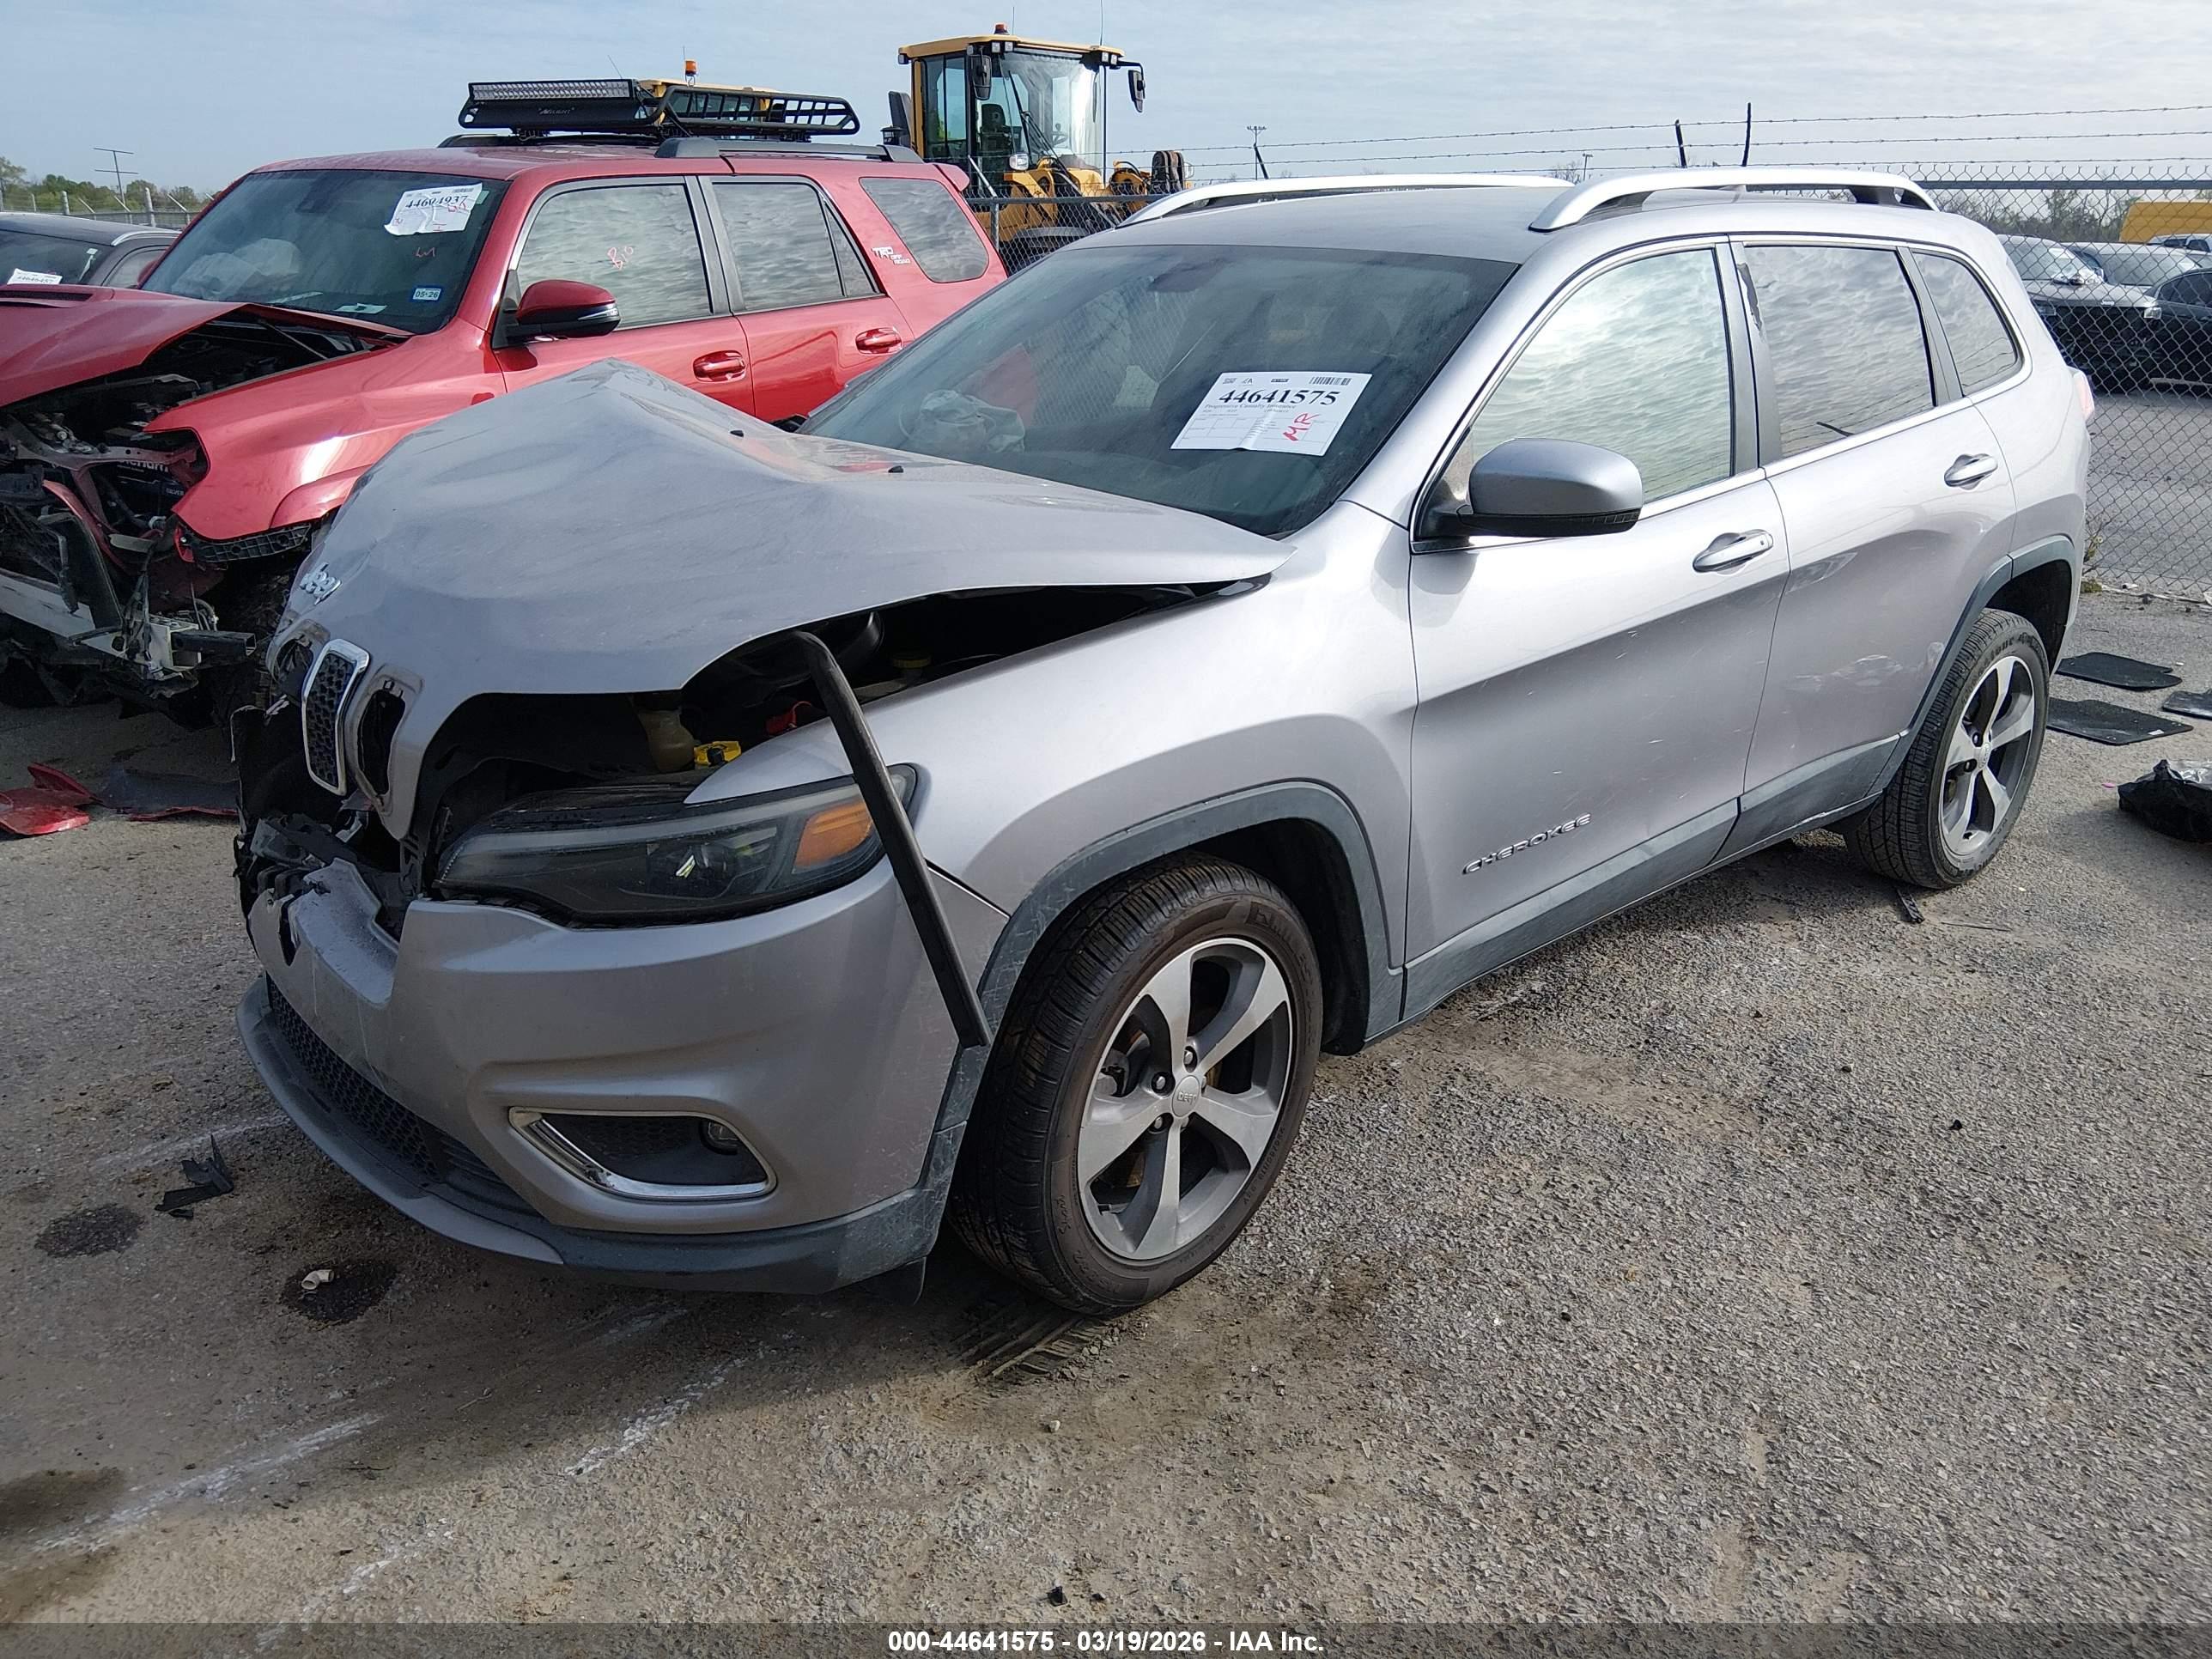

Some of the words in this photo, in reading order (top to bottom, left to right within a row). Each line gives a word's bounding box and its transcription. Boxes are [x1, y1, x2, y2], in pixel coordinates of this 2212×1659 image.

[871, 246, 894, 259] TRD
[1218, 389, 1342, 405] 44641575
[1462, 813, 1591, 874] CHEROKEE
